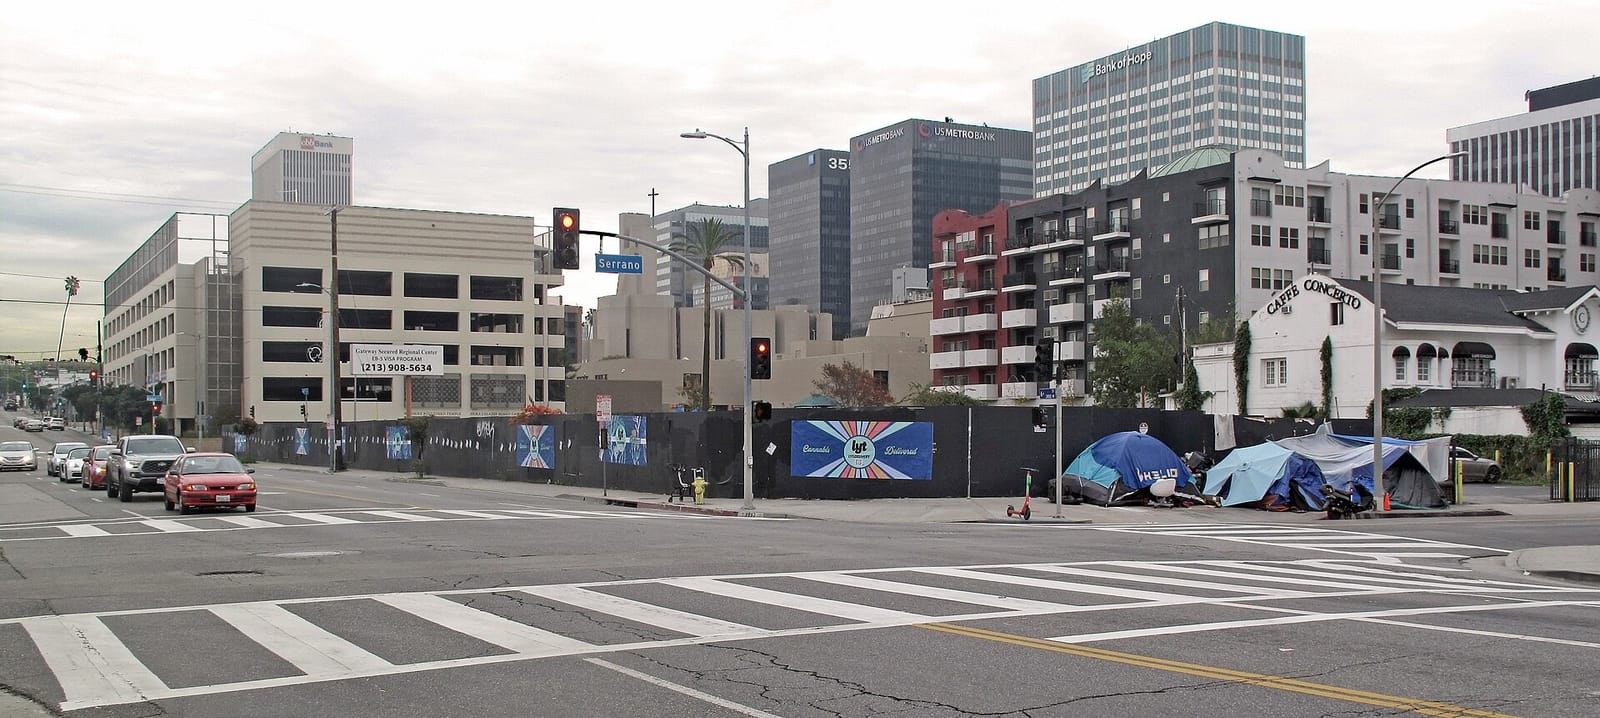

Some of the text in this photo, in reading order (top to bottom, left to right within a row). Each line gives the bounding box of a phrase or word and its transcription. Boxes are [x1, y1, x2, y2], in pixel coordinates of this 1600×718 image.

[1095, 51, 1152, 76] Bank of Hope
[828, 157, 850, 170] 35
[599, 258, 640, 270] Serrano
[1304, 279, 1361, 310] CONCERTO
[361, 363, 432, 372] (213) 908-5634
[851, 440, 867, 454] lyt
[884, 445, 918, 455] Delivered
[1143, 468, 1178, 480] HELIO
